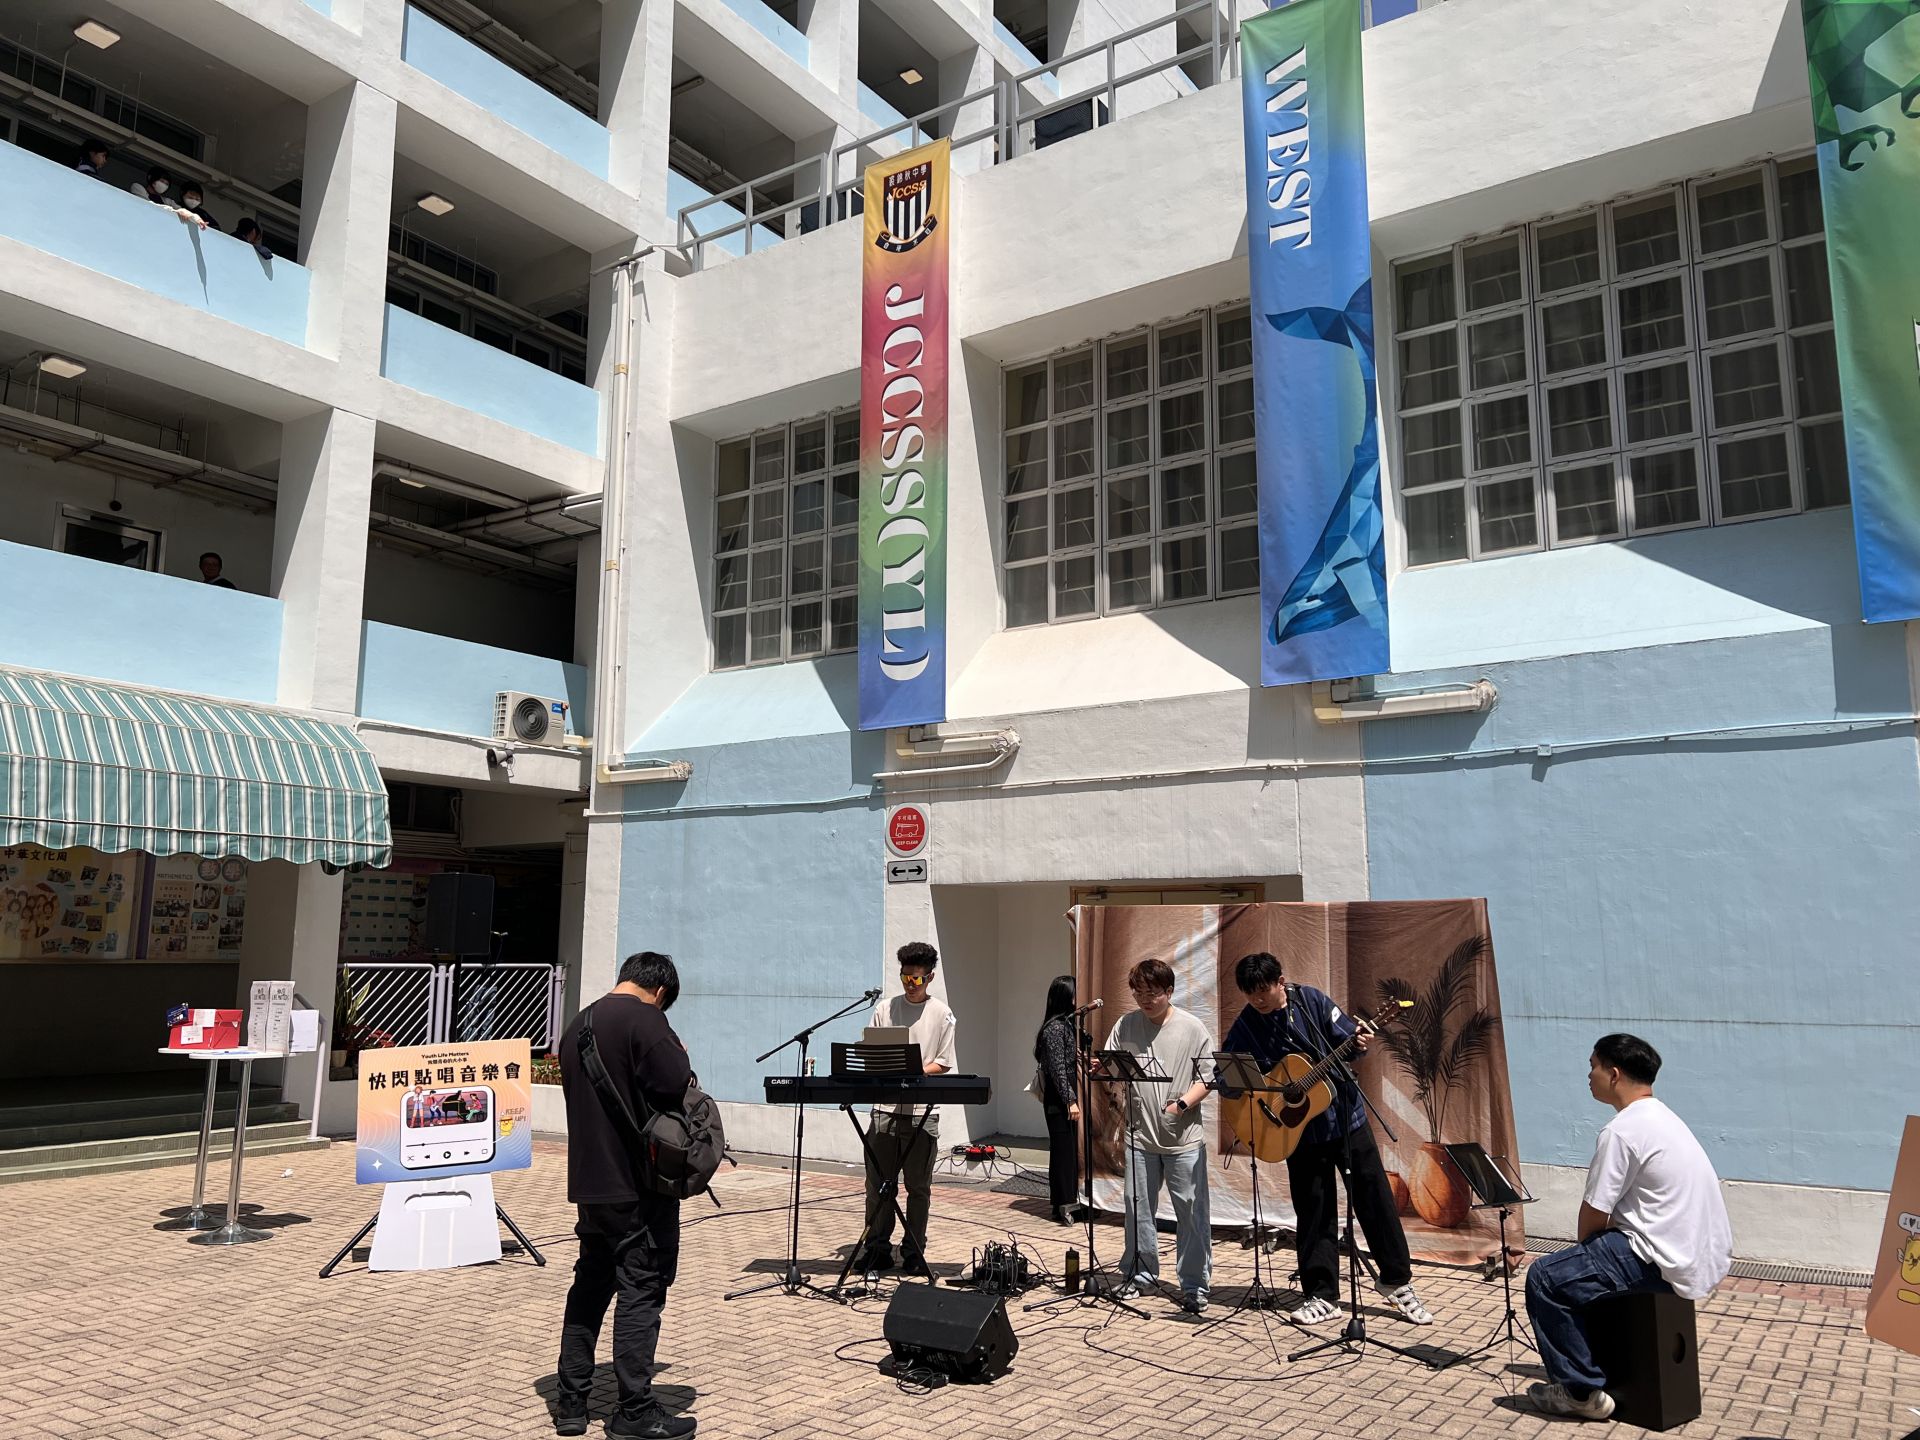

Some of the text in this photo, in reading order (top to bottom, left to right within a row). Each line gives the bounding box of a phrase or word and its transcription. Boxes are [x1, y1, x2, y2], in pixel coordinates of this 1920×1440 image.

[1265, 42, 1312, 250] WEST
[887, 180, 926, 202] JCCSS
[877, 283, 930, 681] JCCSS(YL)
[4, 848, 67, 861] 中華文化周
[368, 1062, 521, 1090] 快閃點唱音樂會
[506, 1107, 525, 1115] KEEP
